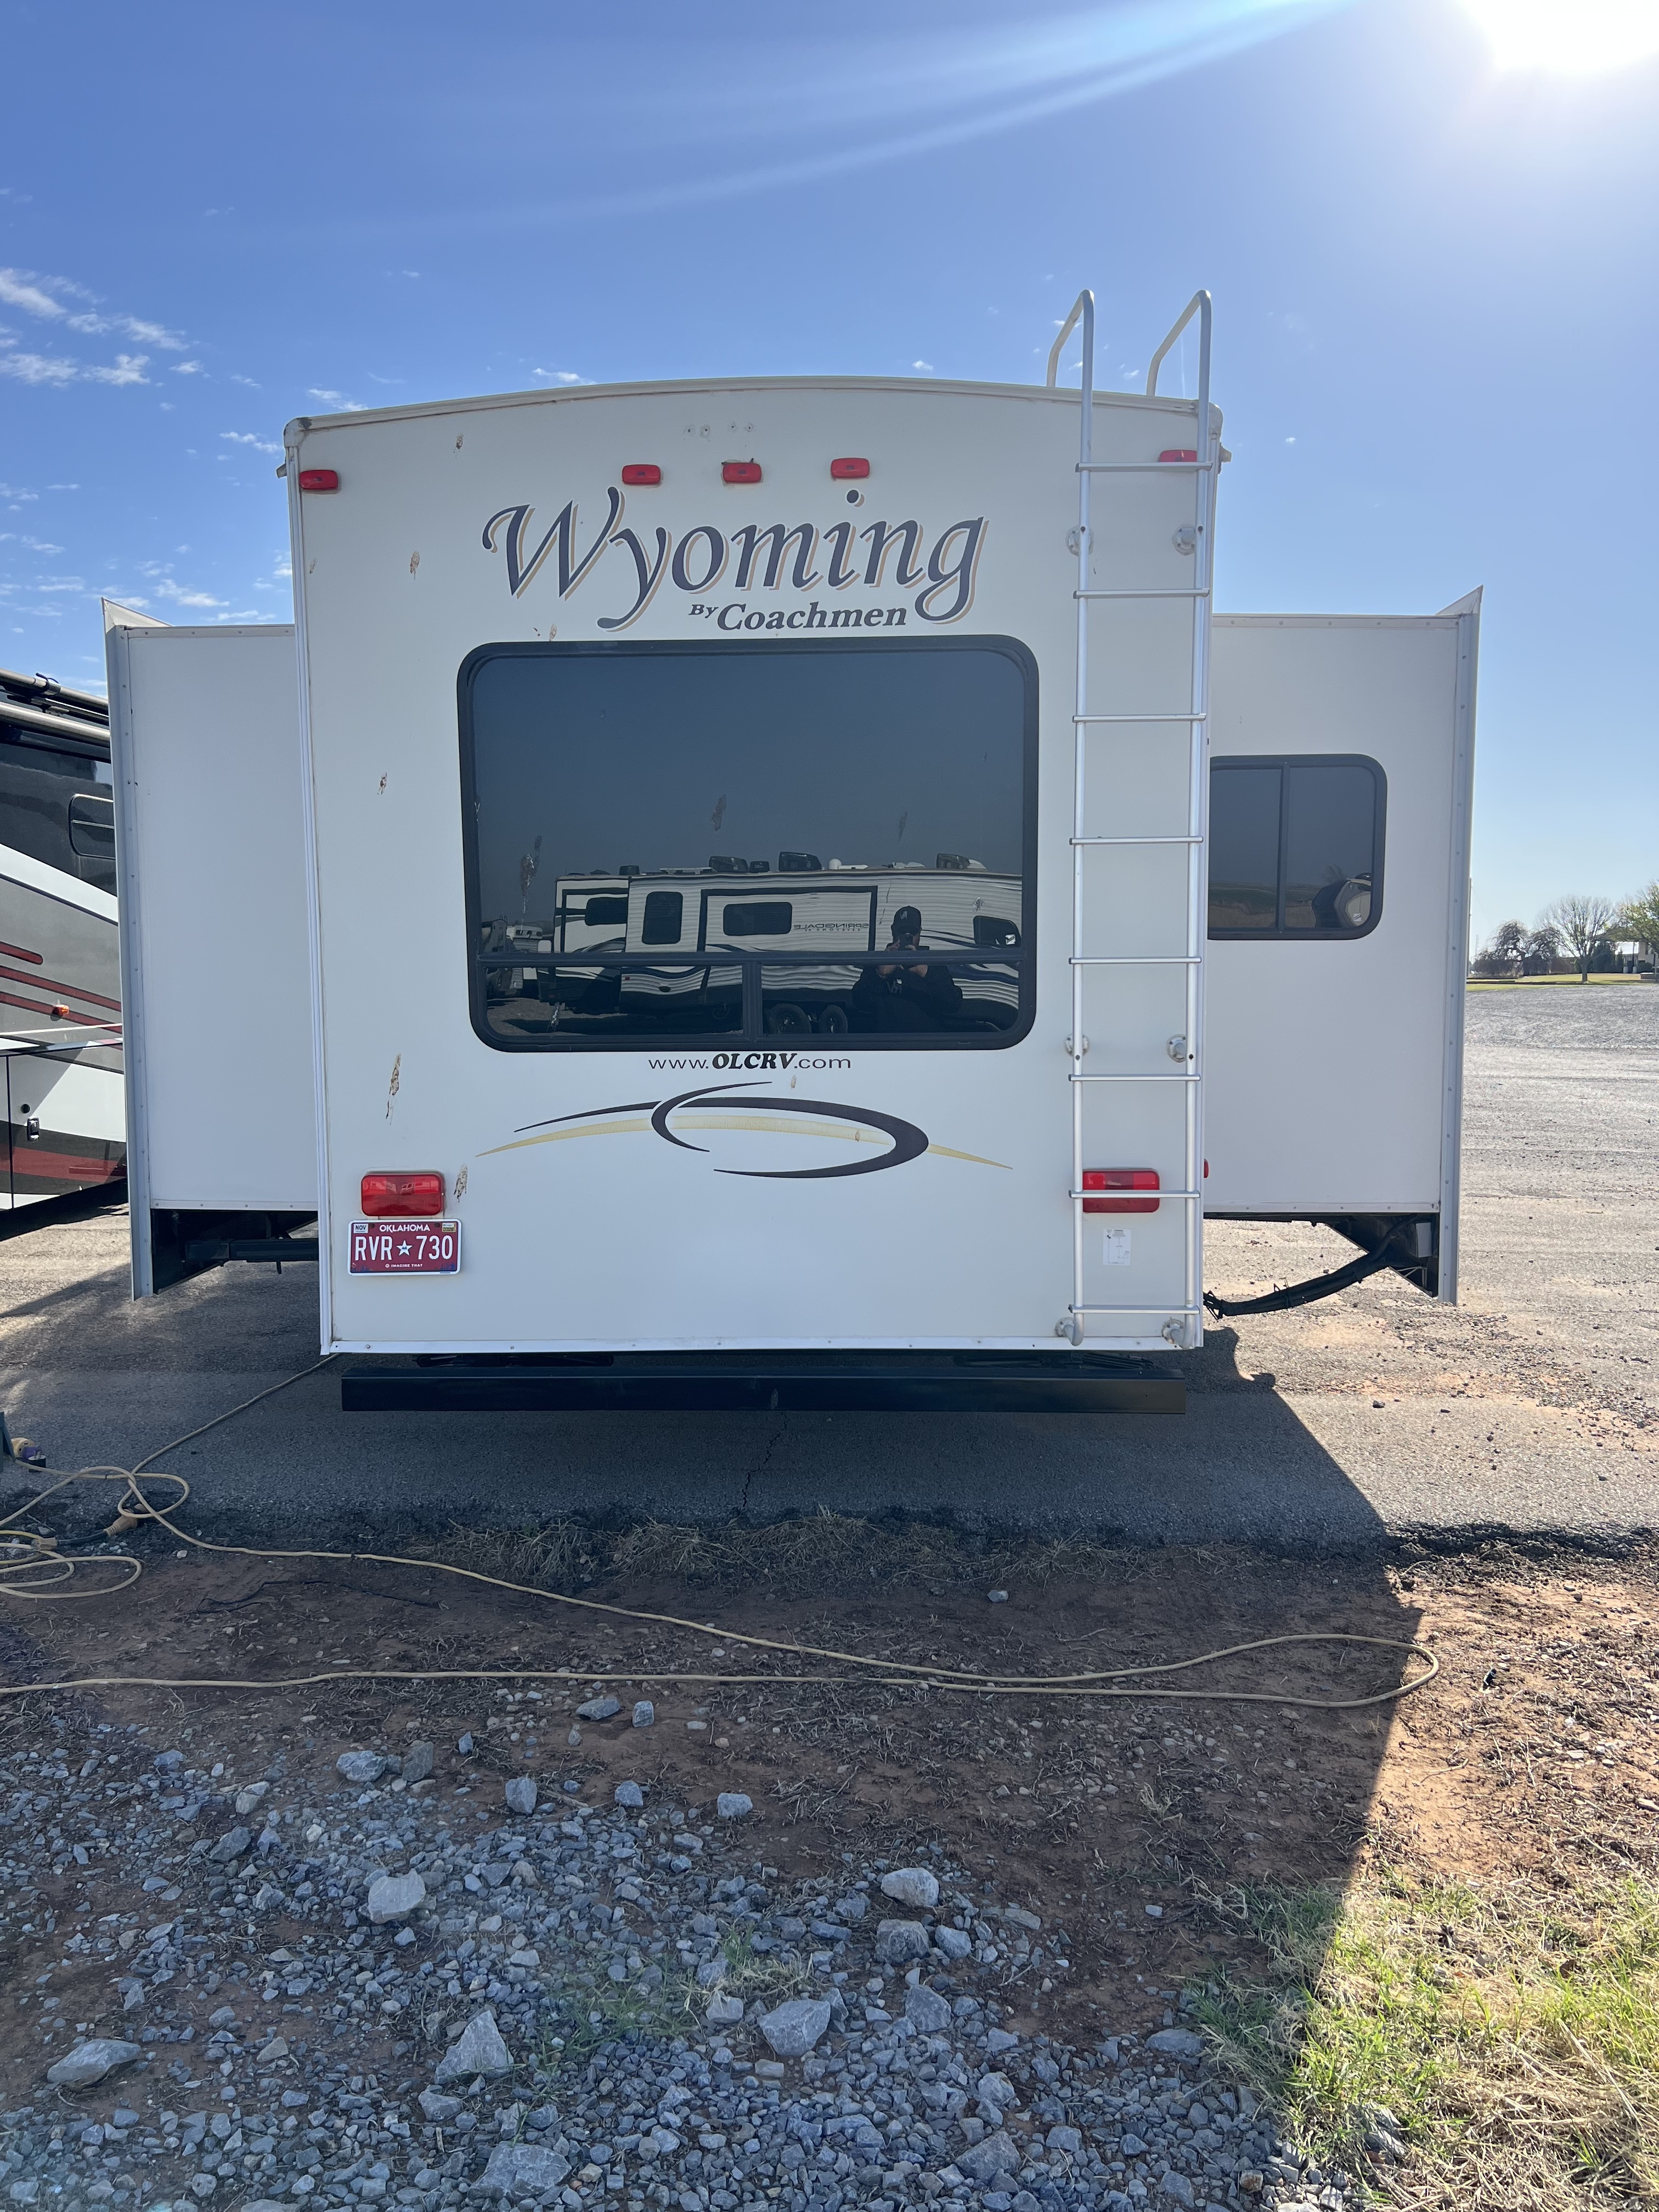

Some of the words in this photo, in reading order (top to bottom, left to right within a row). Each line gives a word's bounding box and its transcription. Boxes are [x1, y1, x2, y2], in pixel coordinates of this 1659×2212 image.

[482, 487, 989, 632] Wyoming
[689, 603, 718, 619] By
[716, 601, 907, 631] Coachmen
[648, 1053, 851, 1069] www.OLCRV.com
[380, 1224, 430, 1233] OKLAHOMA
[355, 1236, 392, 1261] RVR
[416, 1235, 453, 1260] 730
